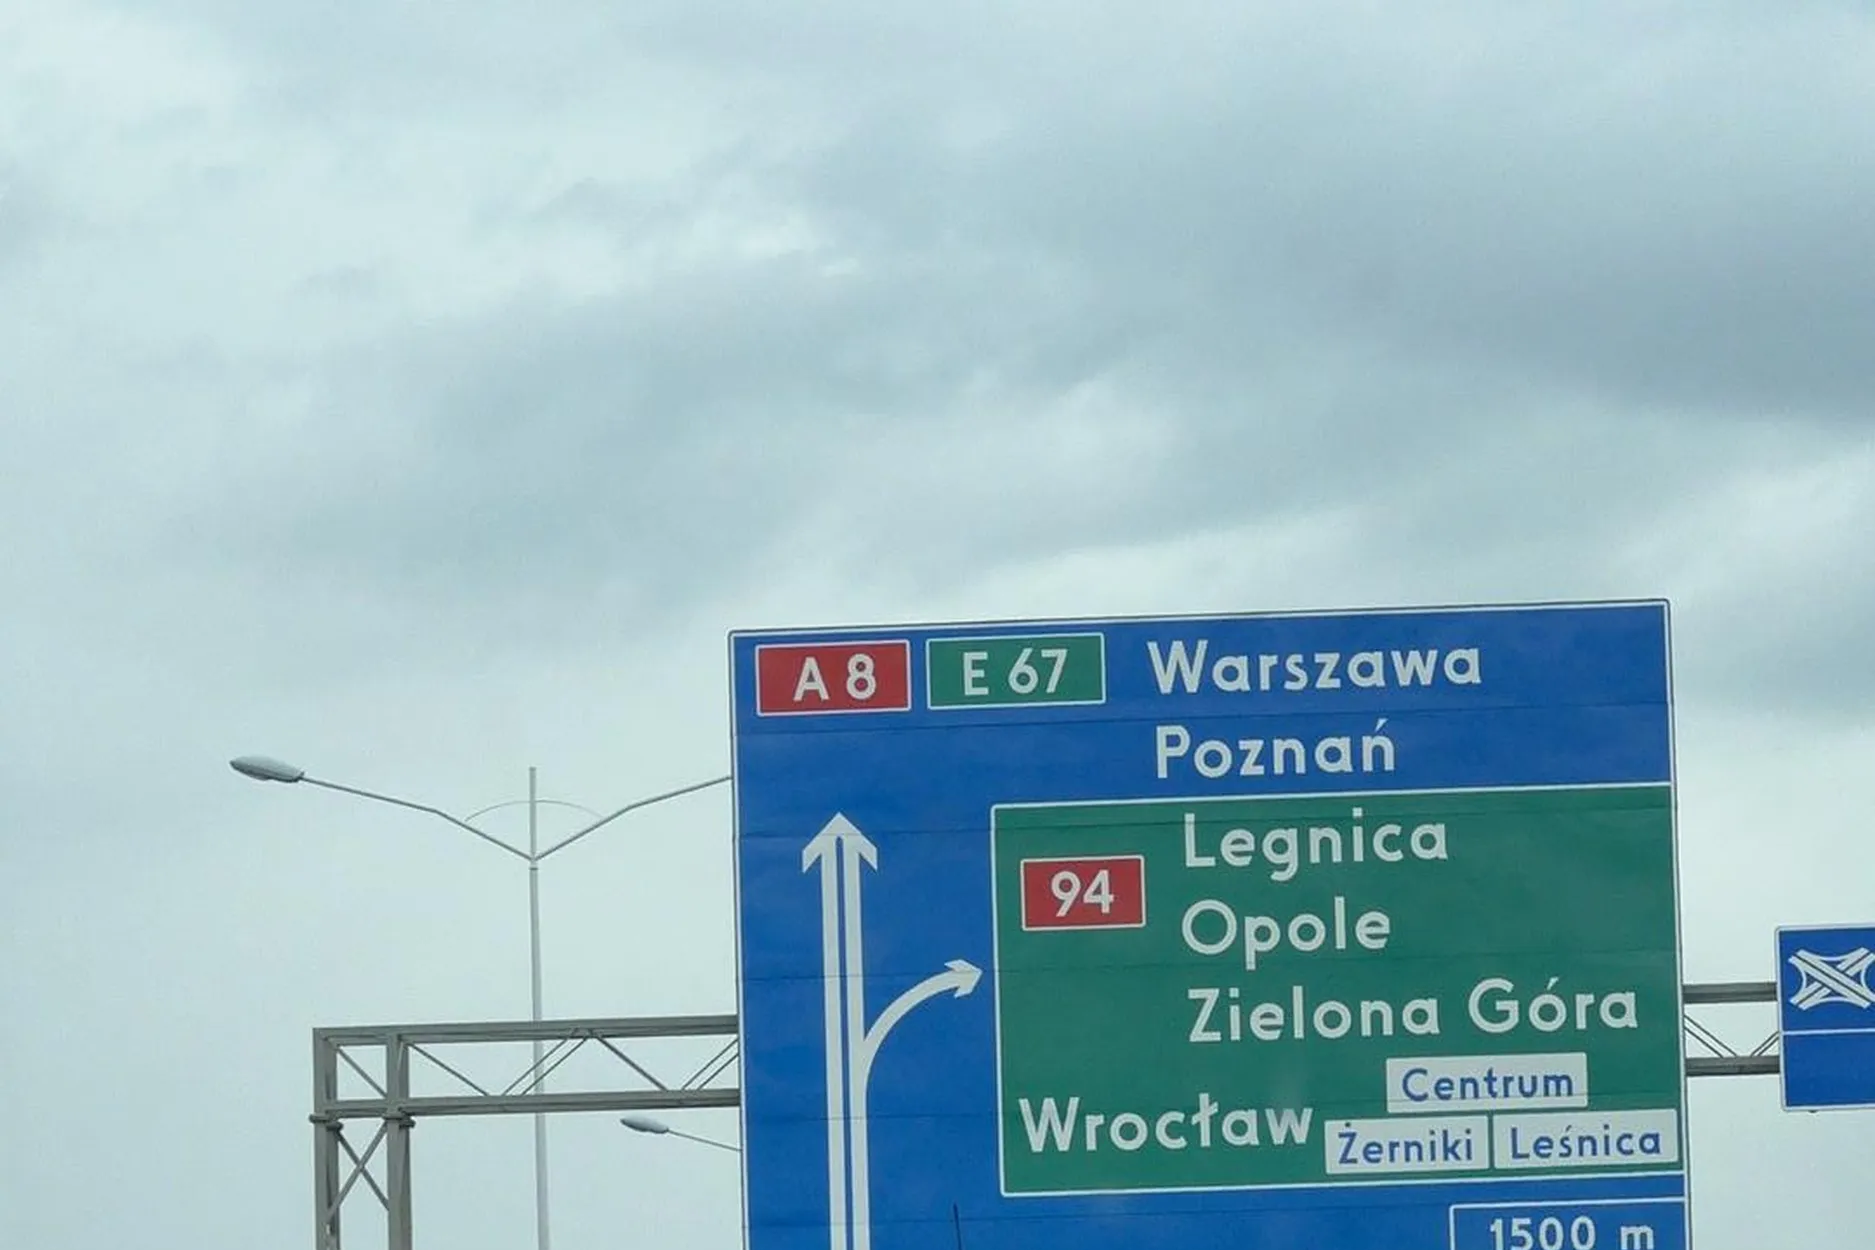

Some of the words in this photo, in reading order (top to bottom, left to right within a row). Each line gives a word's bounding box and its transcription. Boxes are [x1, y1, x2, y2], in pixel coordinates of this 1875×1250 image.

[793, 657, 829, 701] A
[845, 653, 877, 700] 8
[962, 651, 989, 696] E
[1007, 648, 1068, 694] 67
[1147, 639, 1482, 694] Warszawa
[1156, 718, 1395, 779] Poznań
[1184, 808, 1448, 882] Legnica
[1050, 869, 1114, 918] 94
[1182, 897, 1391, 970] Opole
[1188, 985, 1440, 1043] Zielona
[1468, 978, 1639, 1034] Góra
[1401, 1067, 1574, 1103] Centrum
[1019, 1093, 1314, 1153] Wrocław
[1338, 1122, 1473, 1165] Żerniki
[1511, 1121, 1662, 1160] Leśnica
[1621, 1224, 1655, 1250] m
